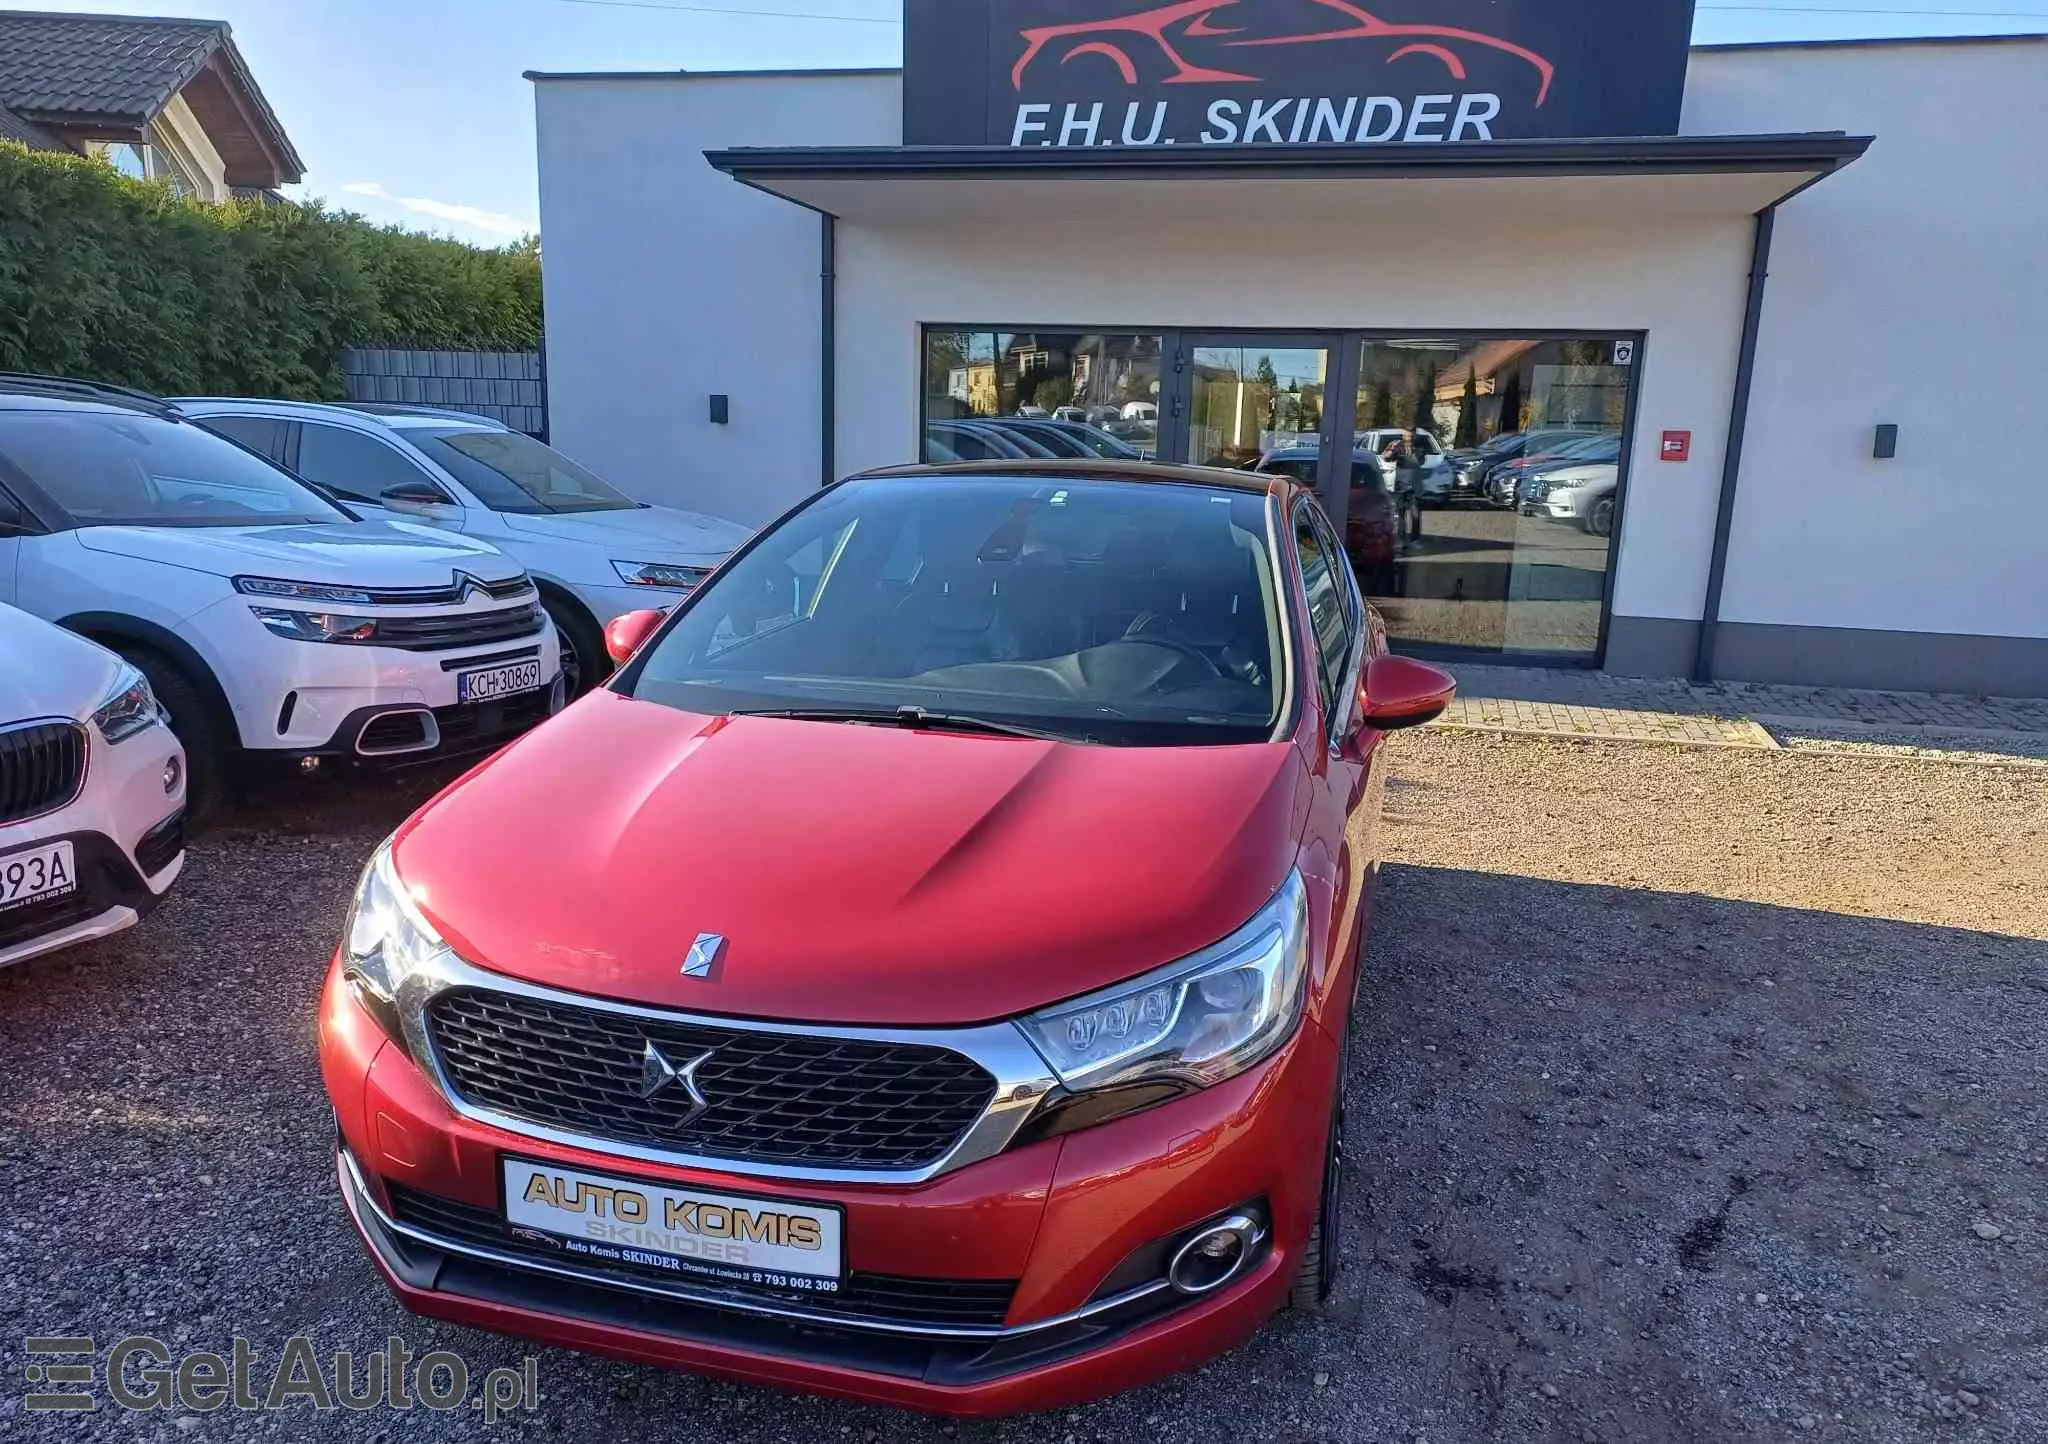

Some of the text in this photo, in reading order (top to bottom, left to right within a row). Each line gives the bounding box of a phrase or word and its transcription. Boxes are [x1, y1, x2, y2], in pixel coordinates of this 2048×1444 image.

[1009, 92, 1500, 147] F.H.U. SKINDER
[523, 1173, 822, 1251] AUTO KOMIS
[565, 1240, 588, 1253] Auto
[590, 1244, 620, 1259] Komis
[622, 1250, 680, 1270] SKINDER
[764, 1274, 787, 1287] 793
[789, 1277, 813, 1290] 002
[816, 1279, 838, 1292] 309
[585, 1220, 750, 1263] SKINDER
